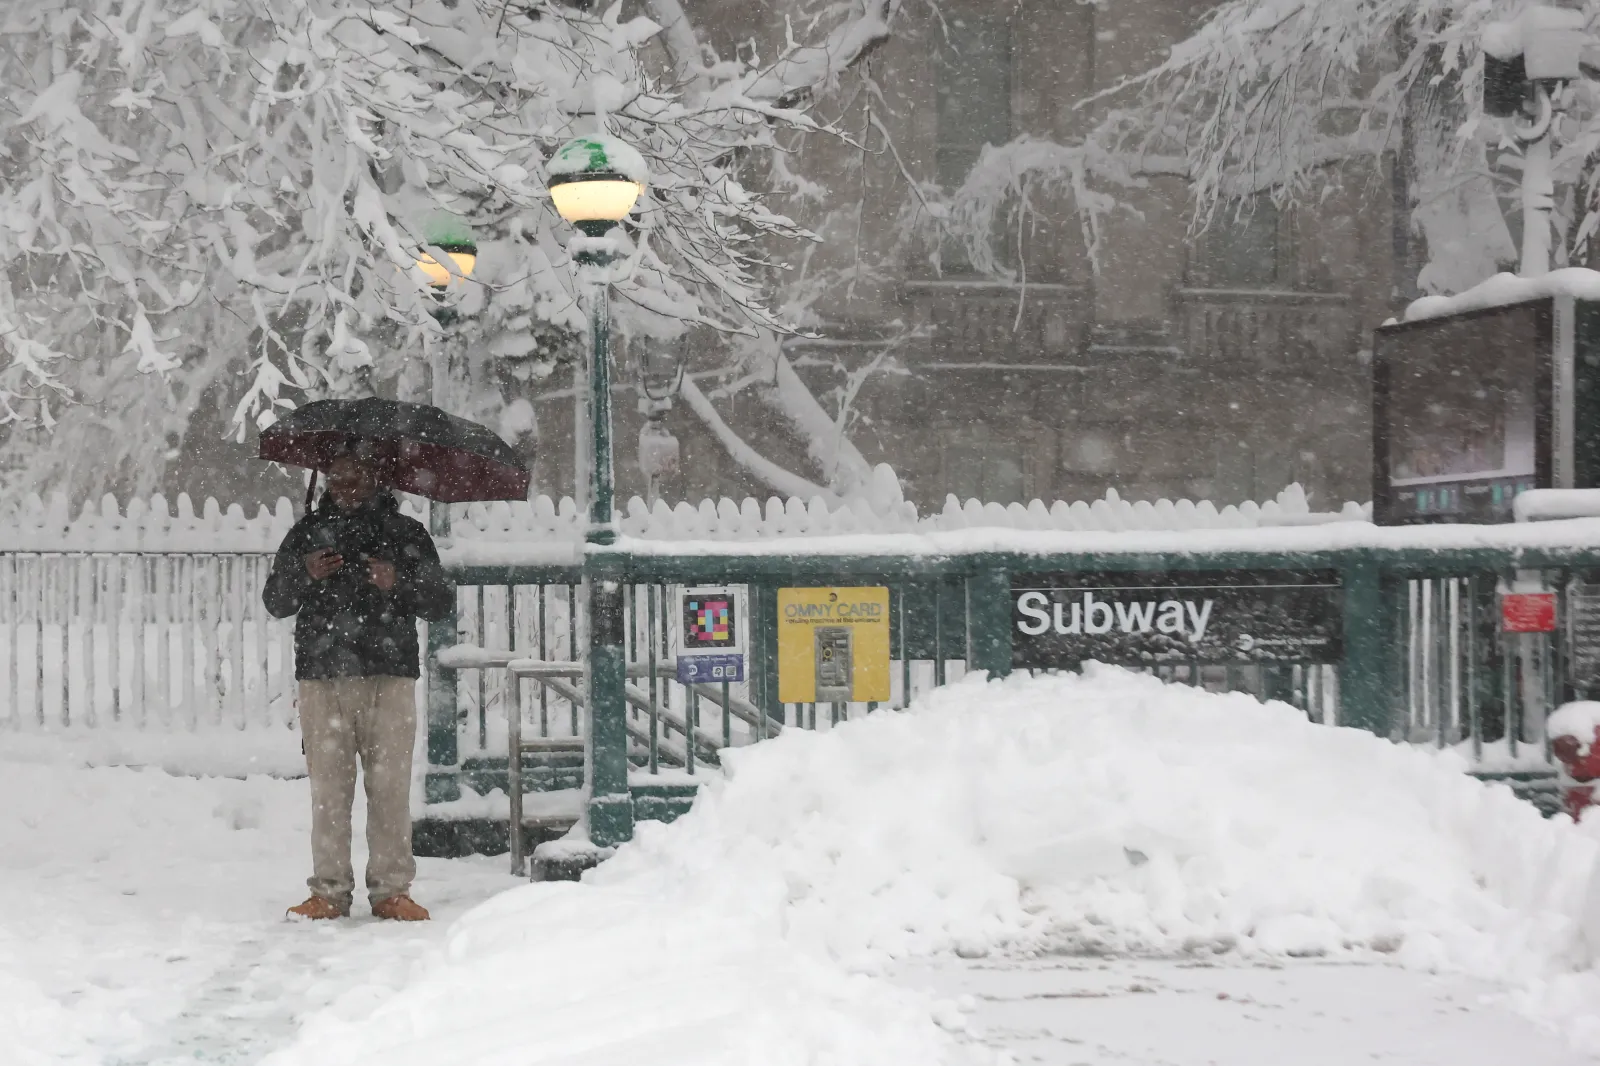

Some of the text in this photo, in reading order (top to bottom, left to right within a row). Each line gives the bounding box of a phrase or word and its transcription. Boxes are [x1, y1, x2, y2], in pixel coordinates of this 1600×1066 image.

[785, 602, 881, 617] OMNY CARD
[1017, 591, 1214, 642] Subway
